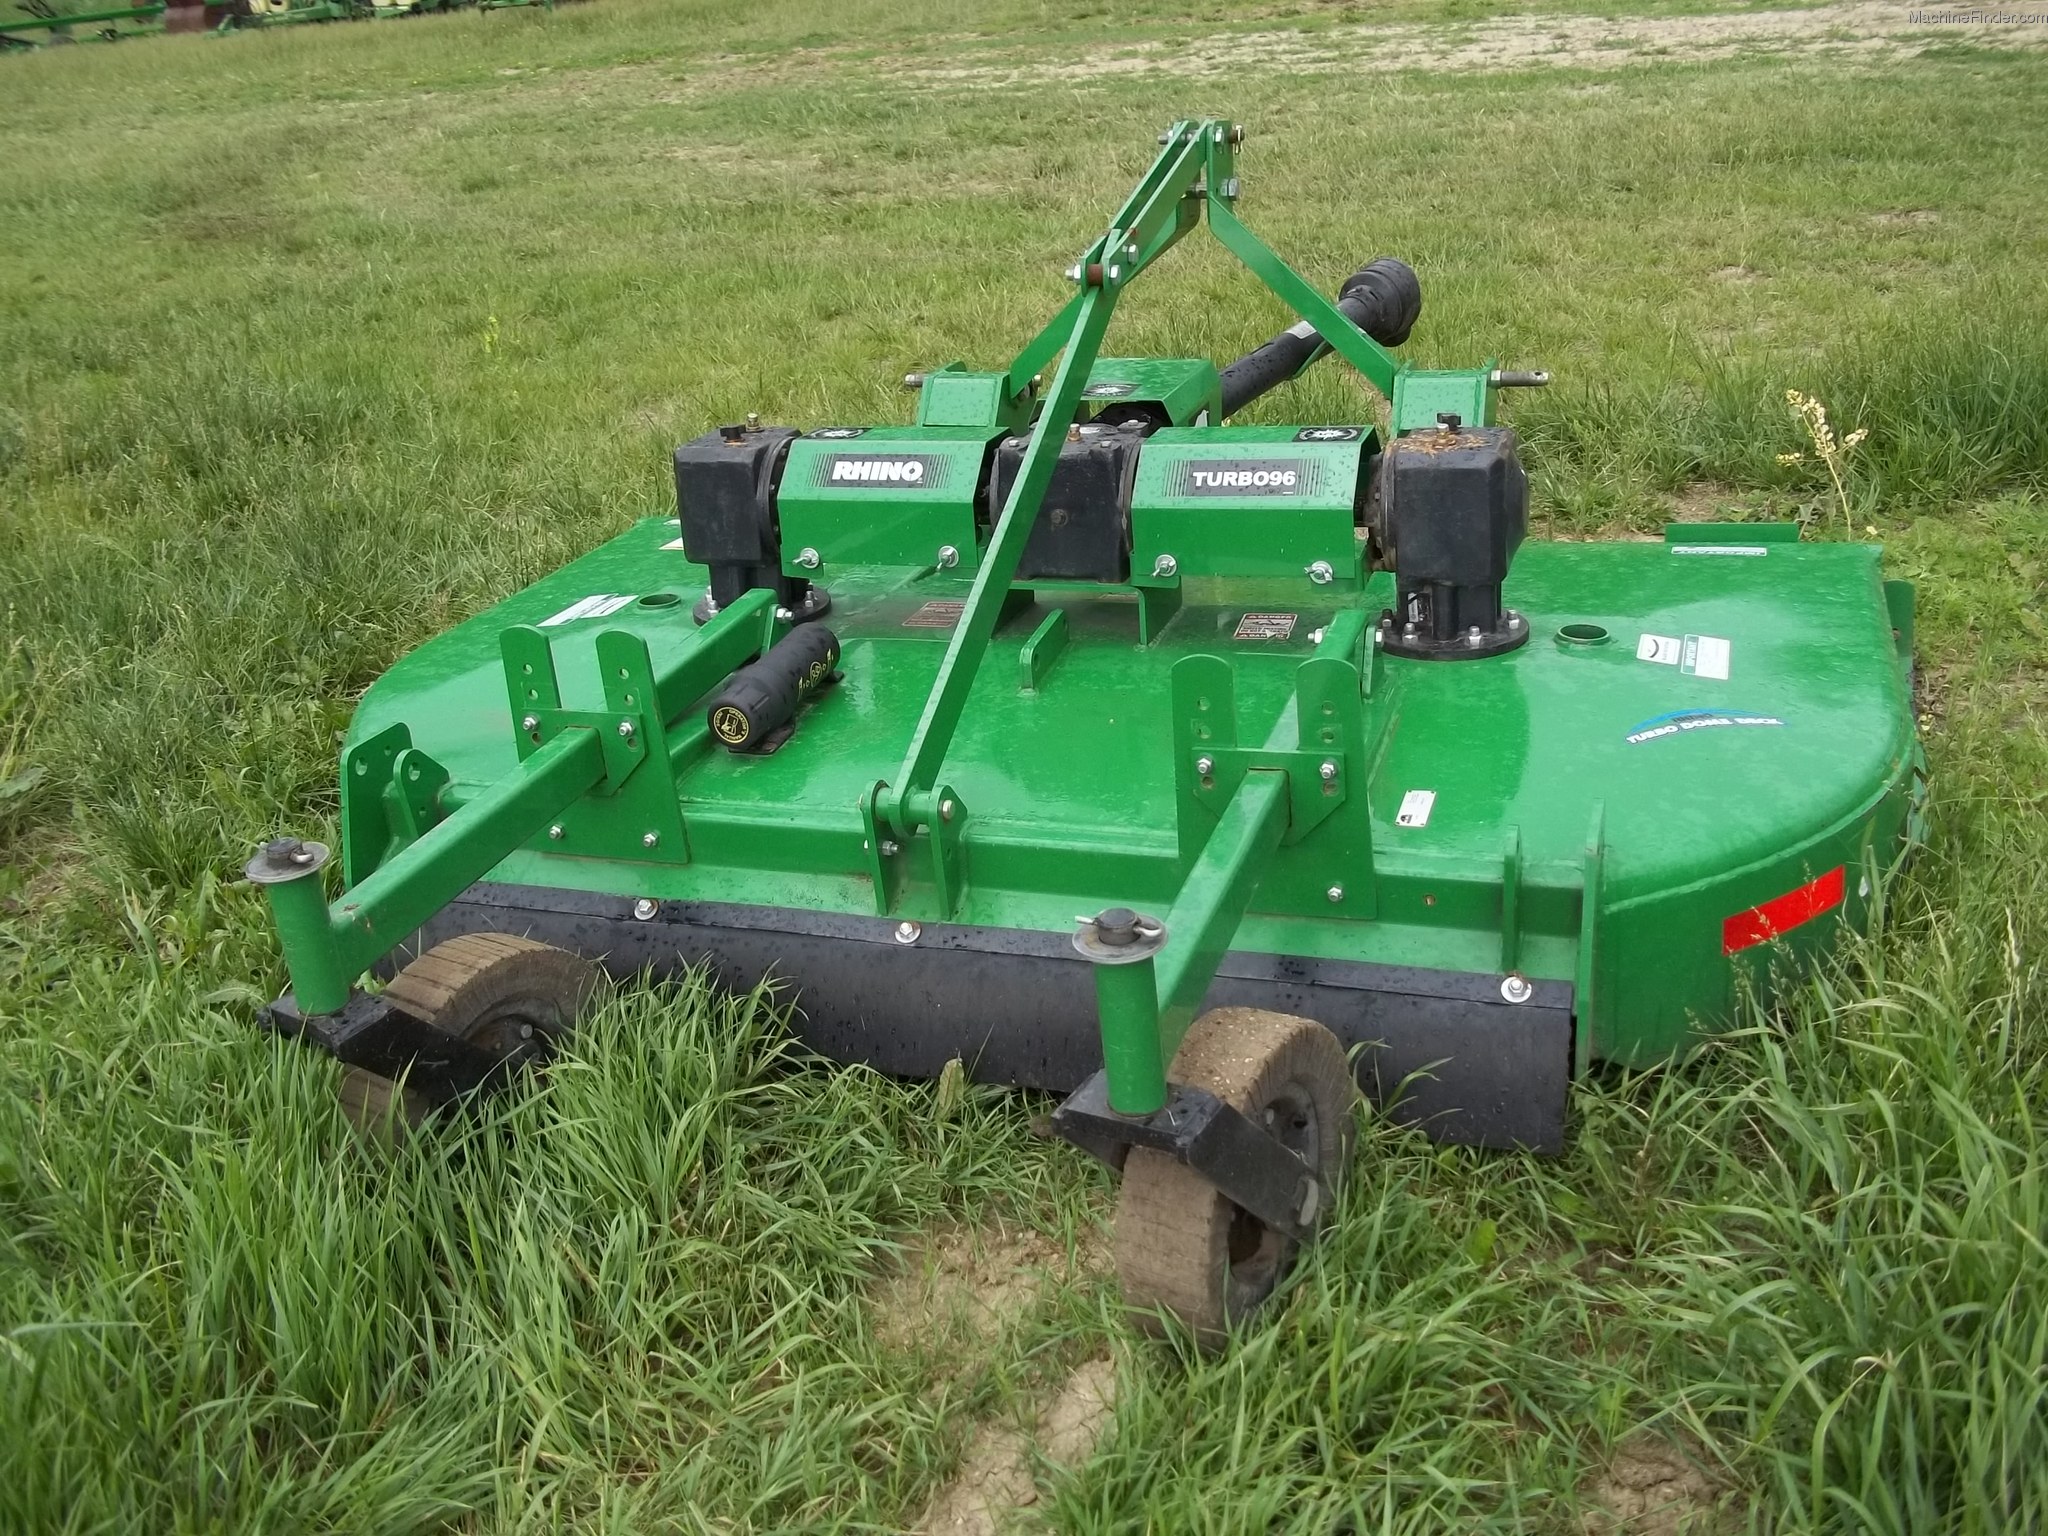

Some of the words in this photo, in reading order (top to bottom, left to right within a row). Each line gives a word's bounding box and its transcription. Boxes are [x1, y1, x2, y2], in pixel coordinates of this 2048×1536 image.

[832, 461, 924, 481] RHINO
[1192, 470, 1296, 487] TURBO96
[1626, 726, 1678, 743] TURBO
